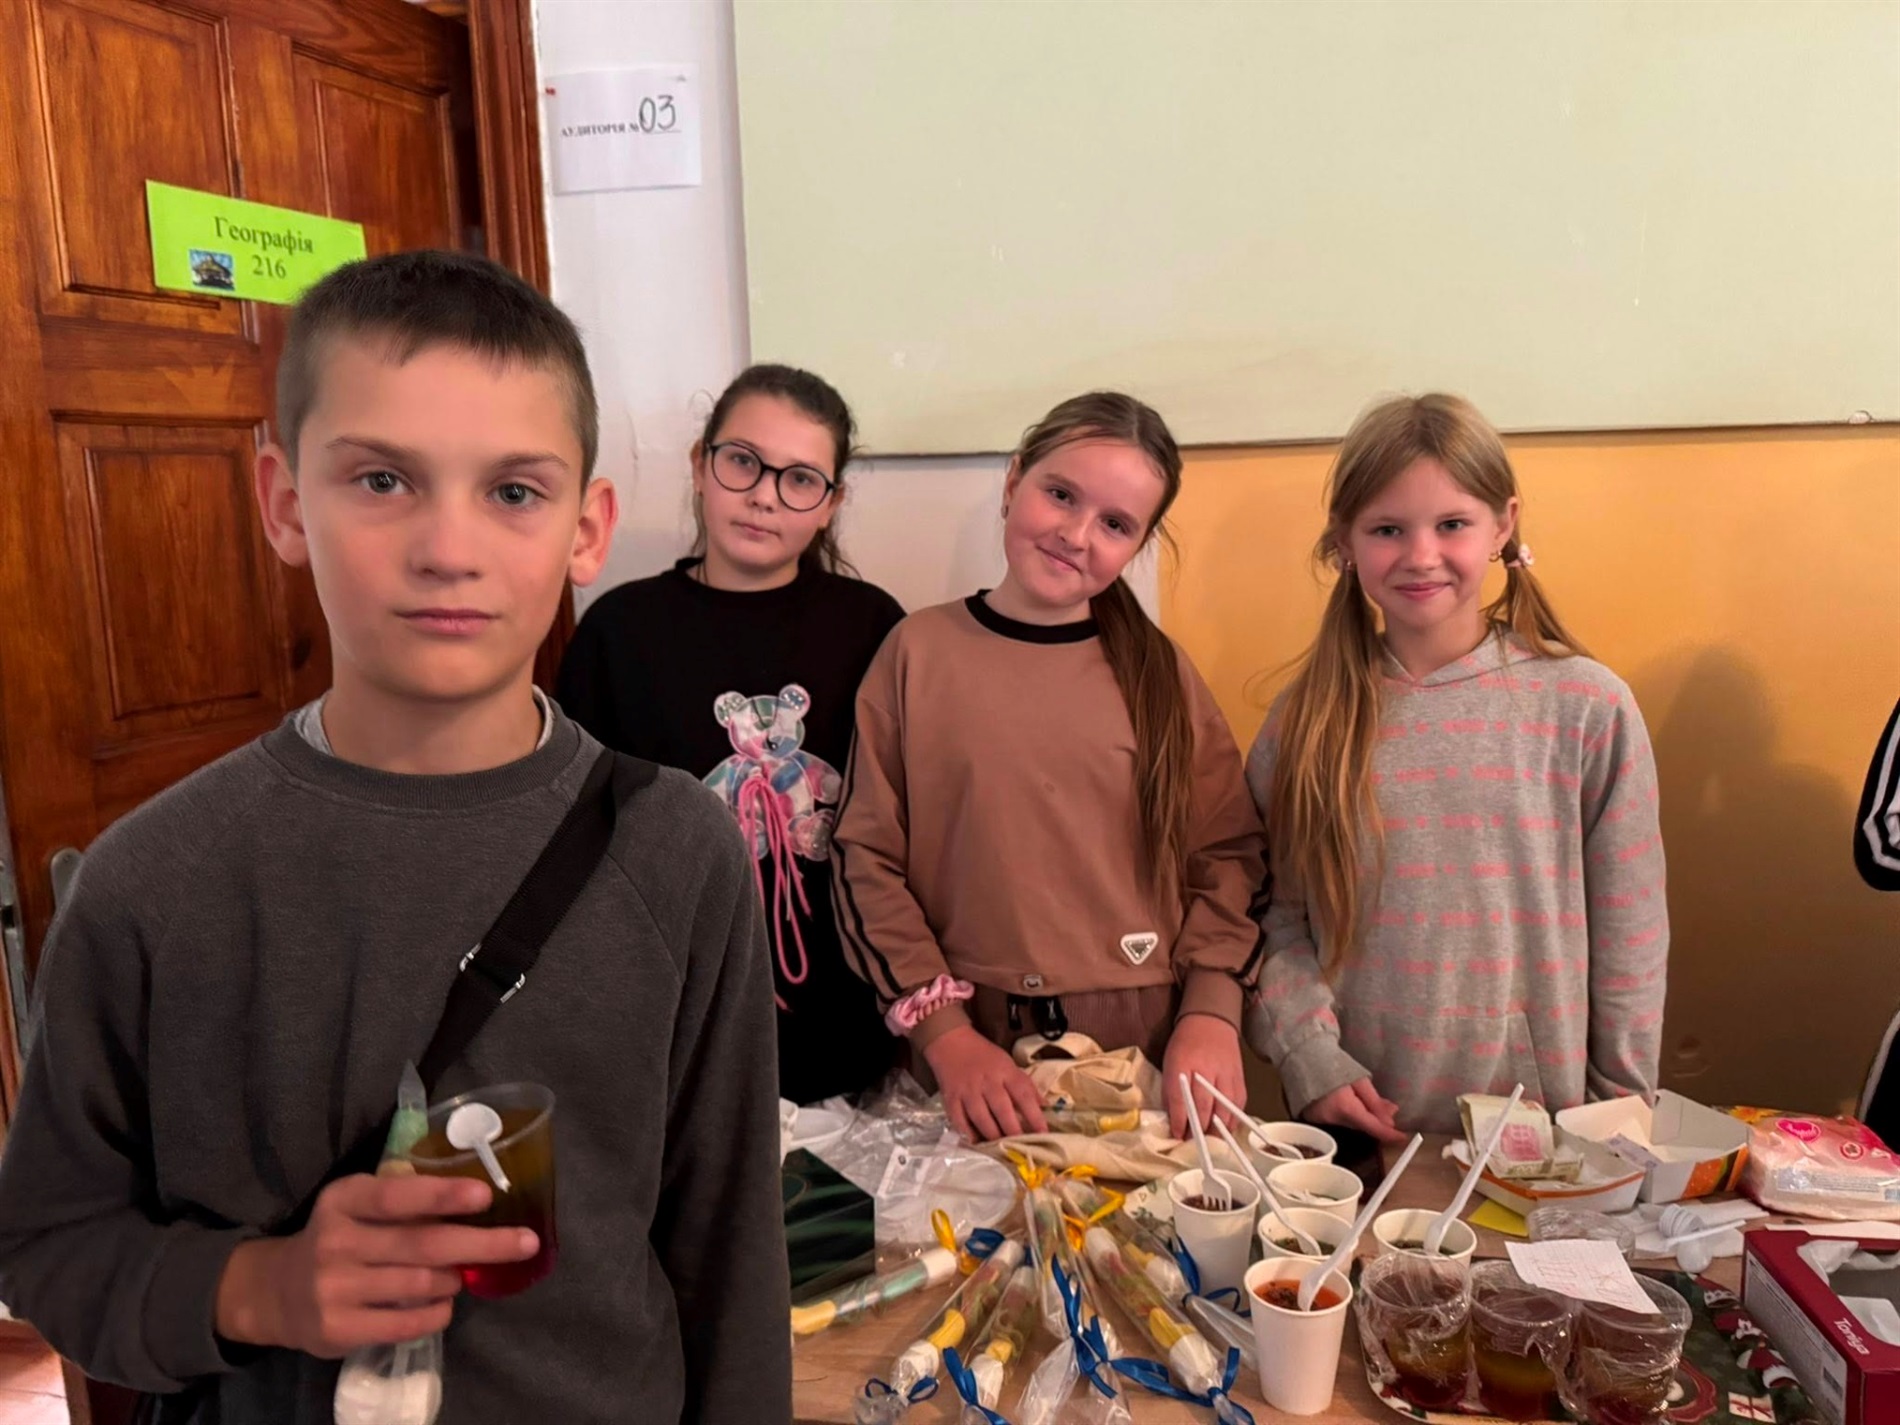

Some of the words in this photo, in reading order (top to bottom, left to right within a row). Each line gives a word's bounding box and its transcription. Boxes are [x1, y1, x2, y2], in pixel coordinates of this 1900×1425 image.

[639, 94, 676, 133] 03
[215, 216, 313, 255] Географія
[253, 255, 286, 278] 216
